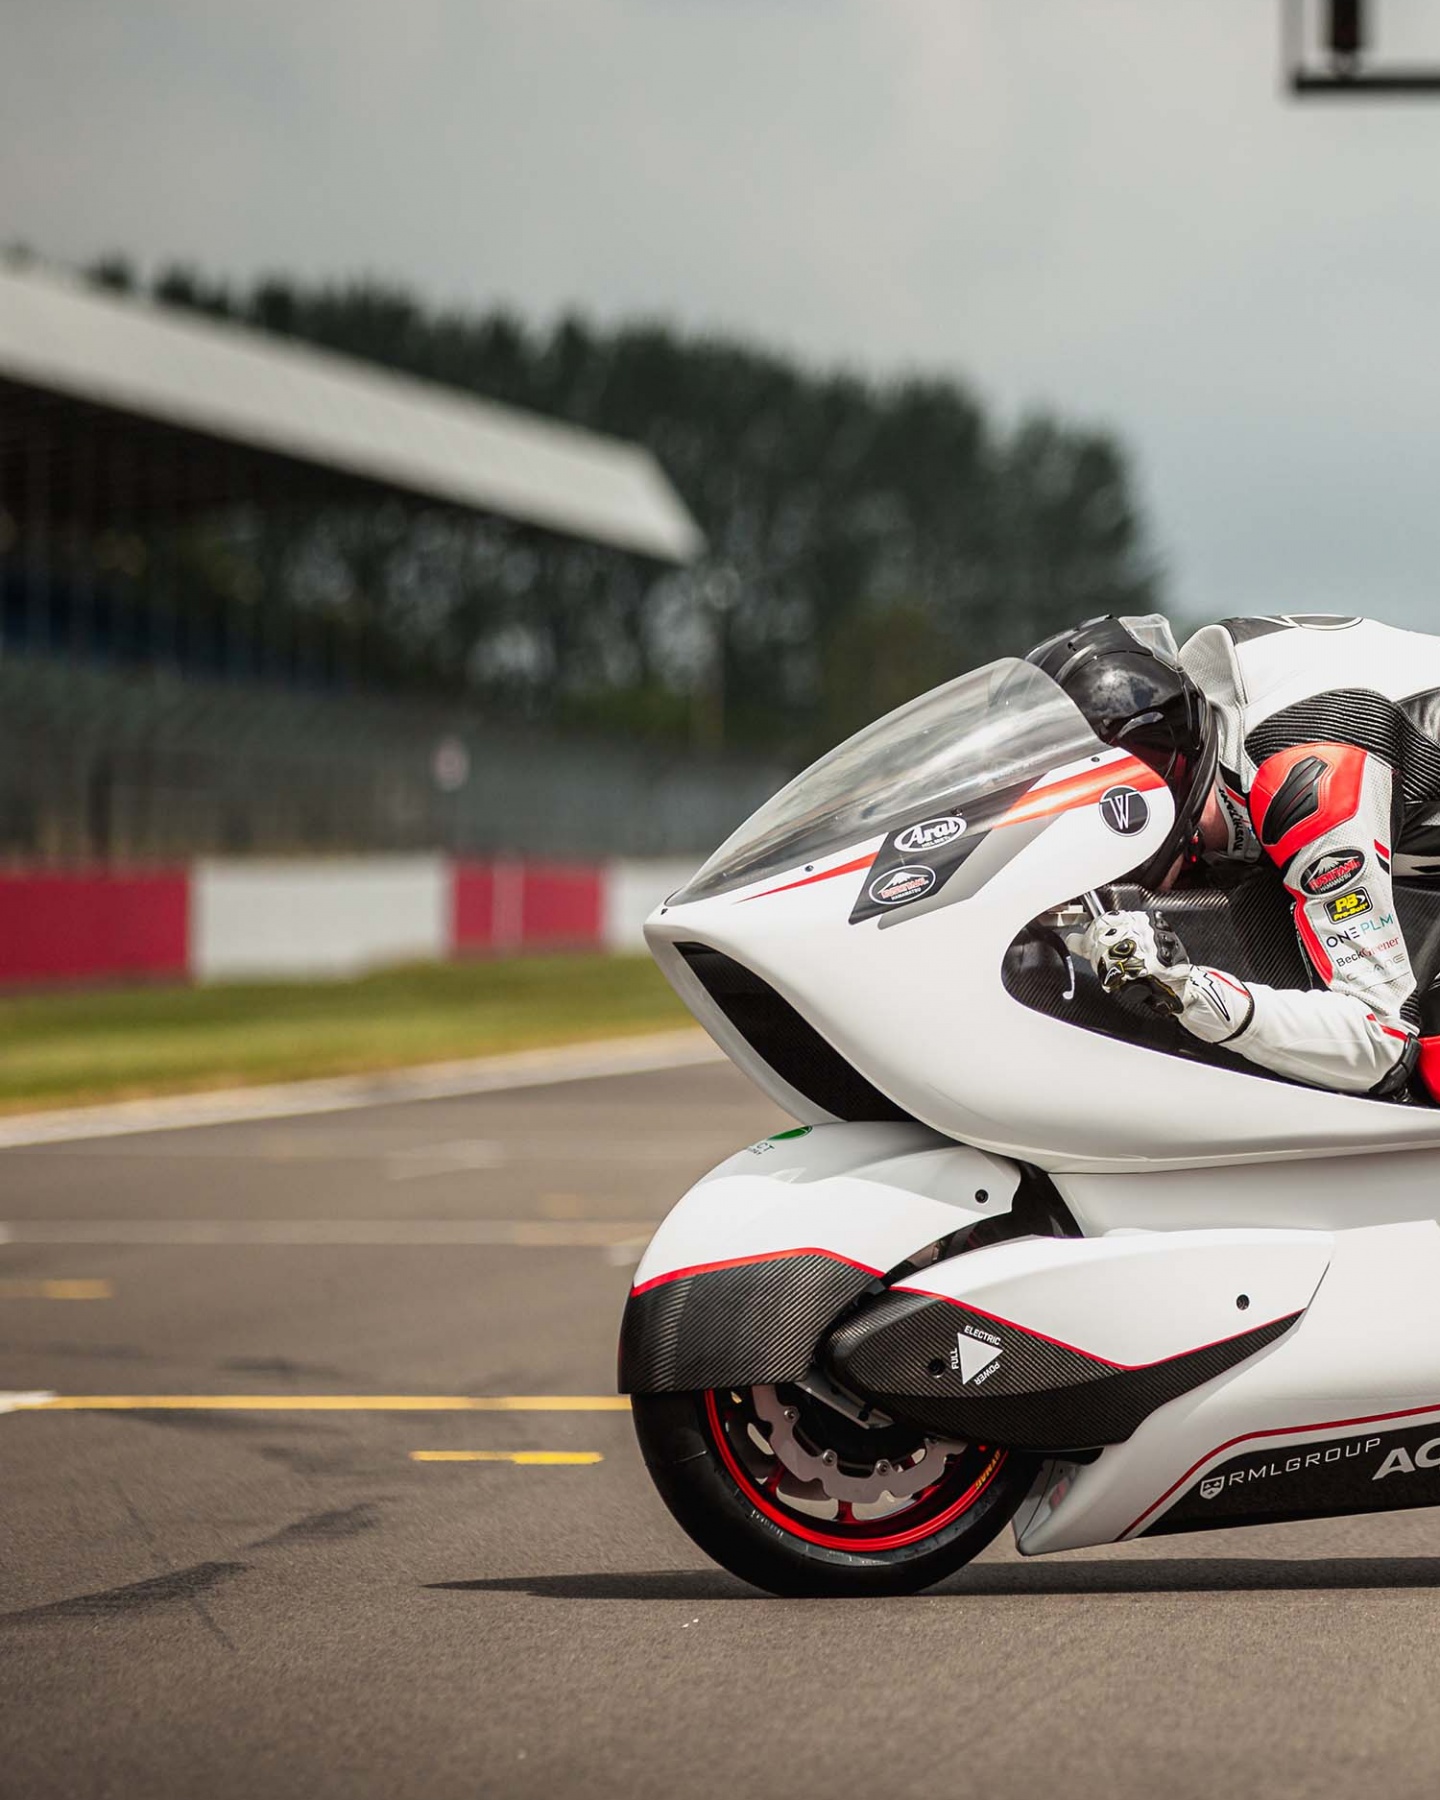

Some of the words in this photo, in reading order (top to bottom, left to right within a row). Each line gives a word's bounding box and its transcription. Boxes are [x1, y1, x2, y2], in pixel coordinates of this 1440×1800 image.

[901, 819, 958, 848] Arai
[1335, 893, 1360, 913] PB
[1326, 926, 1361, 948] ONE
[1360, 913, 1394, 935] PLM
[1336, 937, 1400, 968] BeckGreener
[964, 1325, 1001, 1346] ELECTRIC
[949, 1347, 960, 1370] FULL
[974, 1361, 1001, 1386] POWER
